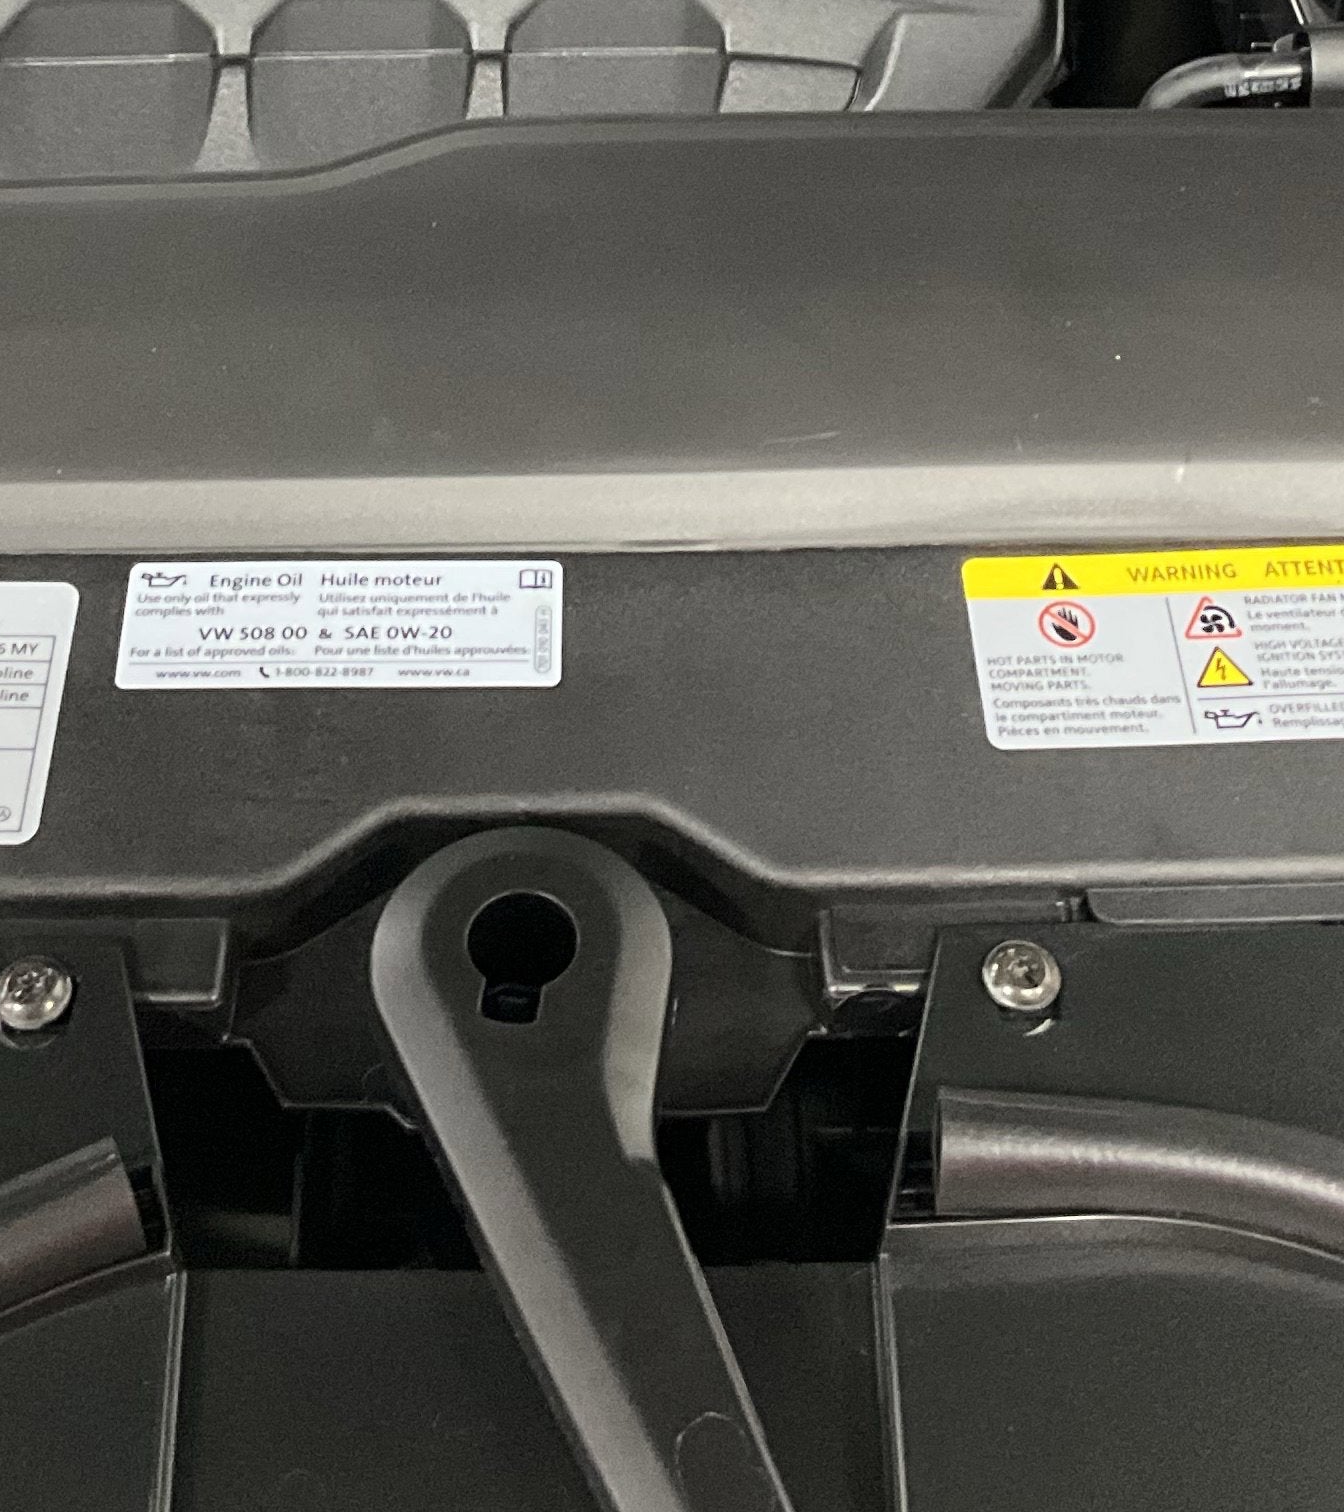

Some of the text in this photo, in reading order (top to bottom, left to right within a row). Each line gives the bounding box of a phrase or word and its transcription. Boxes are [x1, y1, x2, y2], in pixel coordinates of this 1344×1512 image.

[320, 573, 443, 586] Huile moteur
[1126, 563, 1238, 583] WARNING
[209, 573, 303, 591] Engine Oil
[136, 591, 301, 605] Use only oil that expressly
[319, 591, 512, 605] Utilisez uniquement de l'huile
[1244, 593, 1307, 605] RADIATOR
[1311, 592, 1337, 603] FAN
[135, 605, 225, 618] complies with
[317, 605, 339, 618] qui
[342, 605, 393, 616] satisfait
[396, 604, 487, 618] expressément
[198, 625, 453, 640] VW 508 00 & SAE 0W-20
[10, 642, 39, 655] MY
[129, 646, 151, 657] For
[153, 649, 162, 657] a
[164, 646, 185, 657] list
[187, 645, 203, 657] of
[203, 645, 266, 658] approved
[314, 645, 344, 656] Pour
[346, 646, 371, 655] une
[373, 644, 399, 655] liste
[1254, 639, 1286, 651] HIGH
[986, 652, 1125, 667] HOT PARTS IN MOTOR
[991, 681, 1044, 692] MOVING
[993, 696, 1073, 710] Composants
[1102, 694, 1148, 706] chauds
[1150, 693, 1182, 704] dans
[996, 711, 1008, 722] le
[1010, 710, 1106, 723] compartiment
[1043, 726, 1061, 736] en
